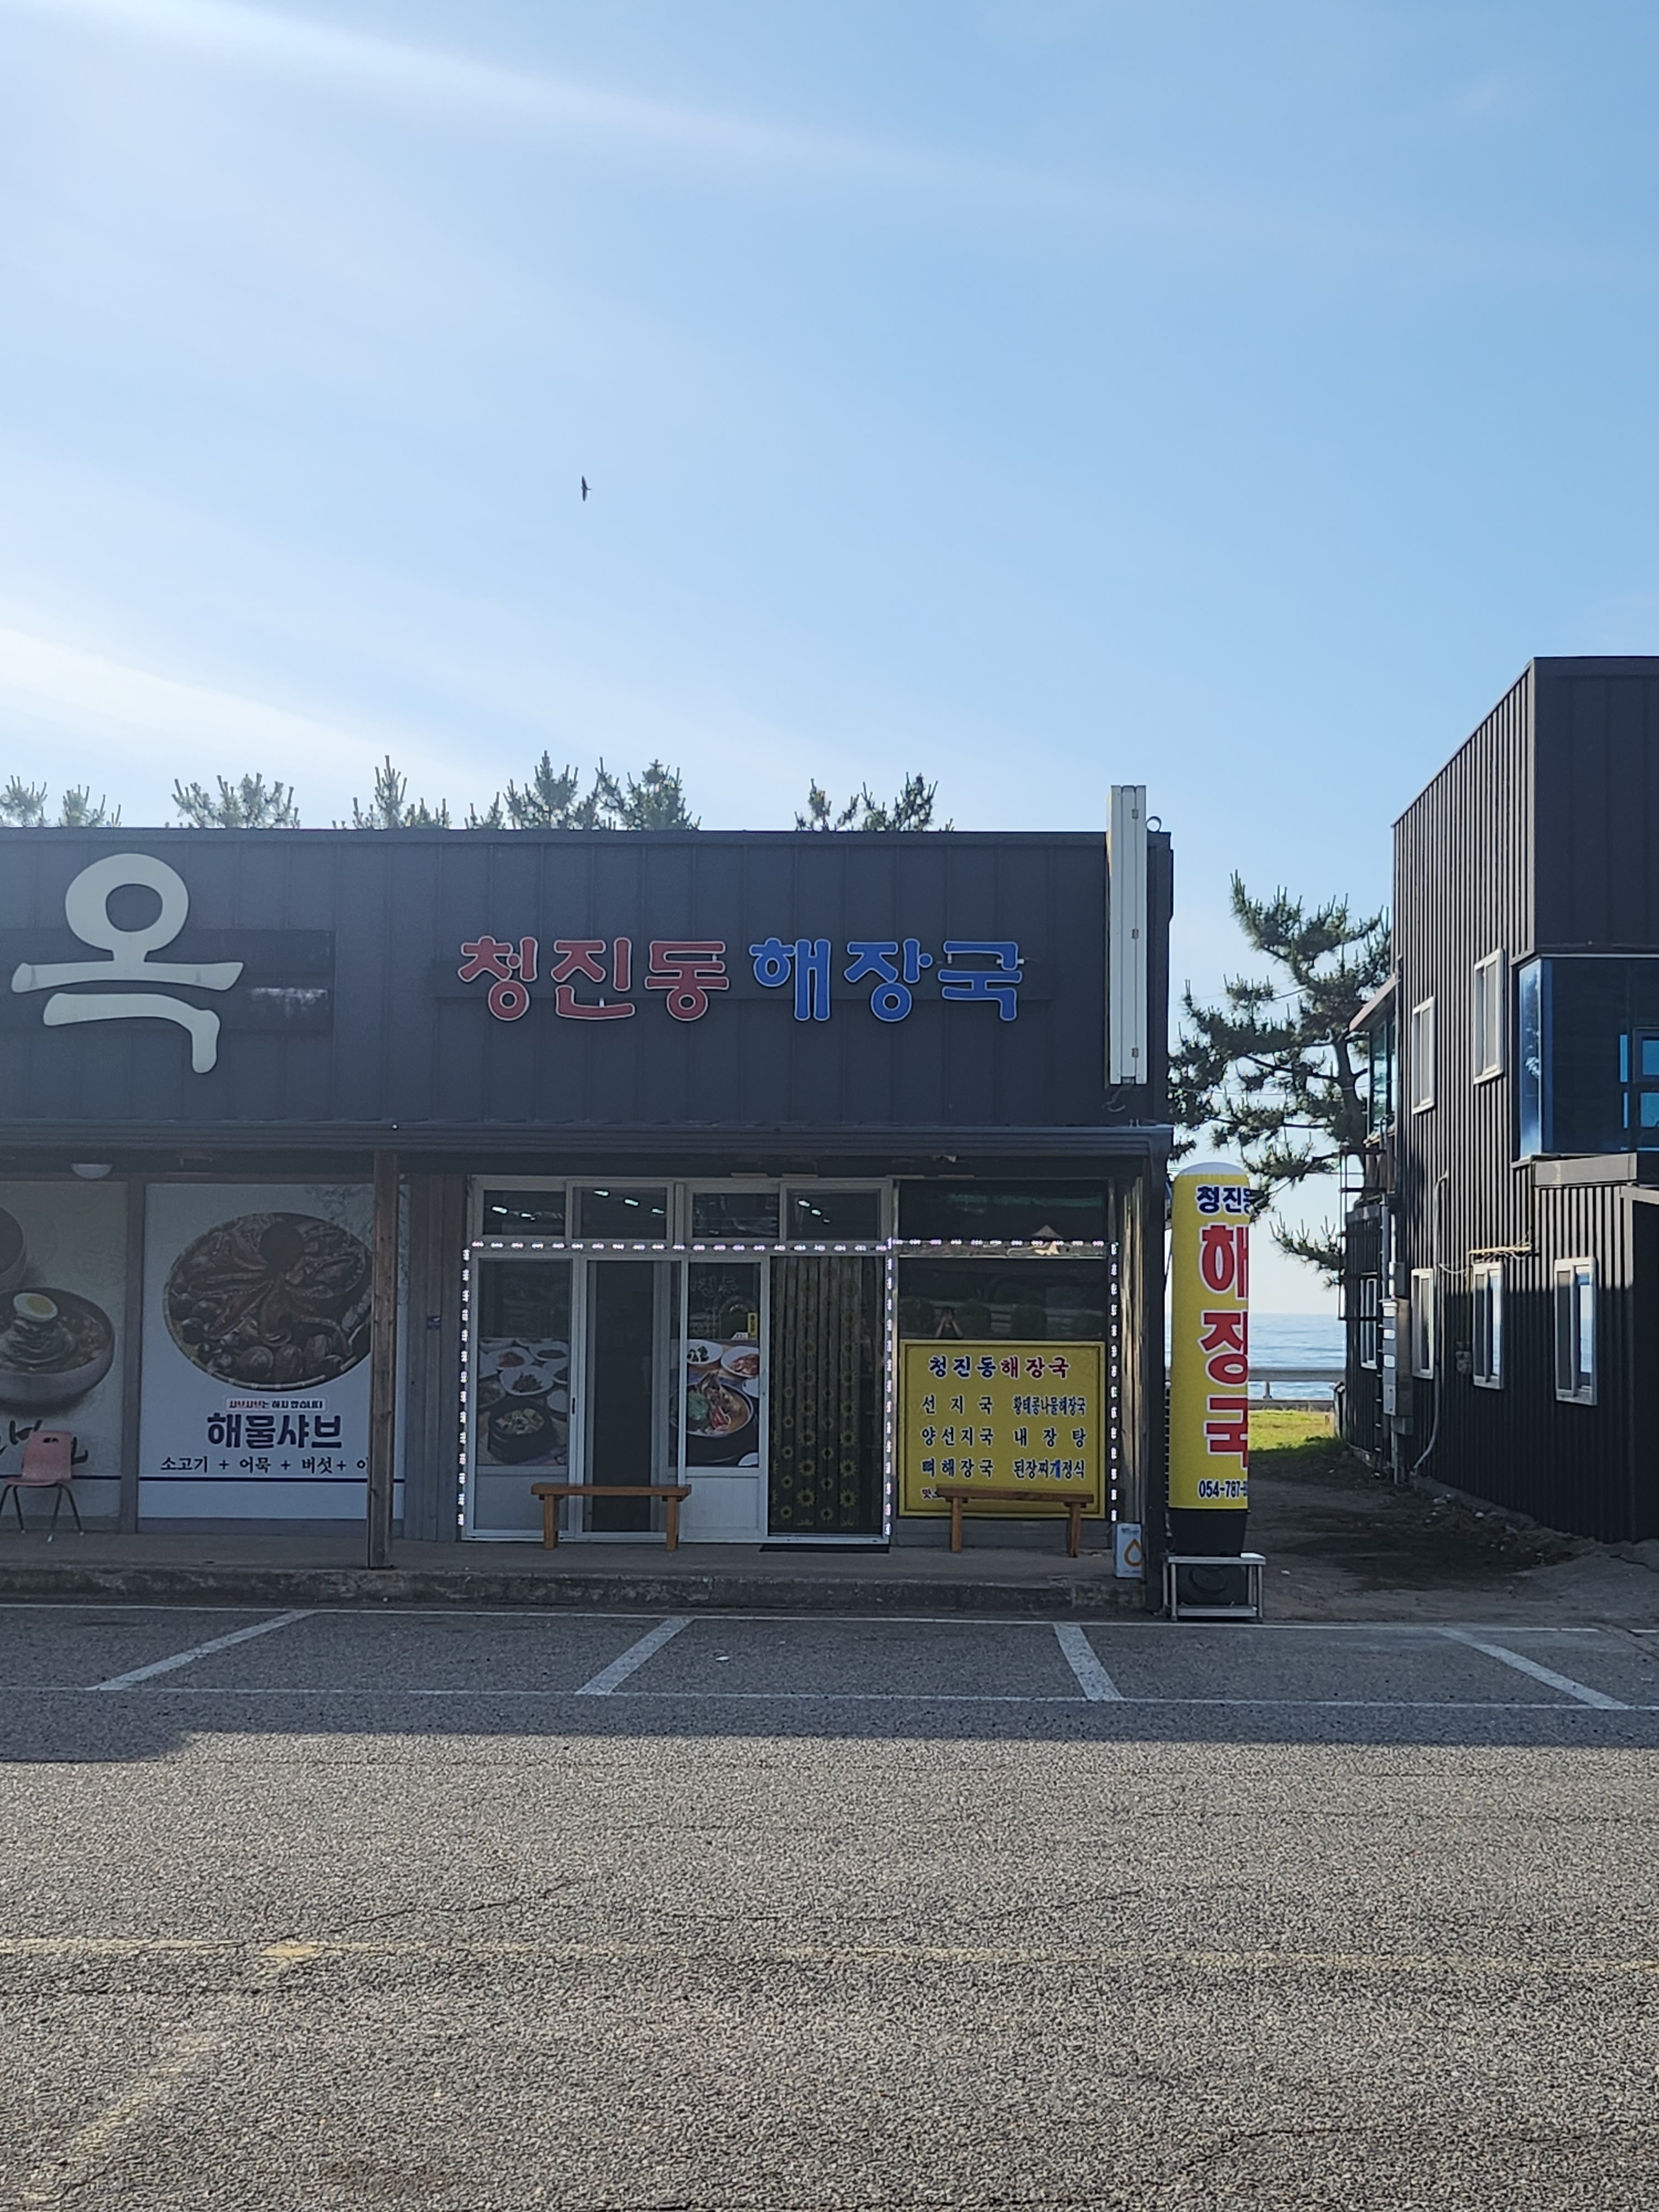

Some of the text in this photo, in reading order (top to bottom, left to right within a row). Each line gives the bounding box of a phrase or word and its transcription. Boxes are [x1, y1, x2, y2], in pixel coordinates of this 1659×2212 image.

[11, 853, 244, 1074] 옥
[458, 936, 1023, 1021] 청진동 해장국
[207, 1412, 342, 1448] 해물샤브
[160, 1456, 208, 1473] 소고기
[239, 1456, 272, 1473] 어묵
